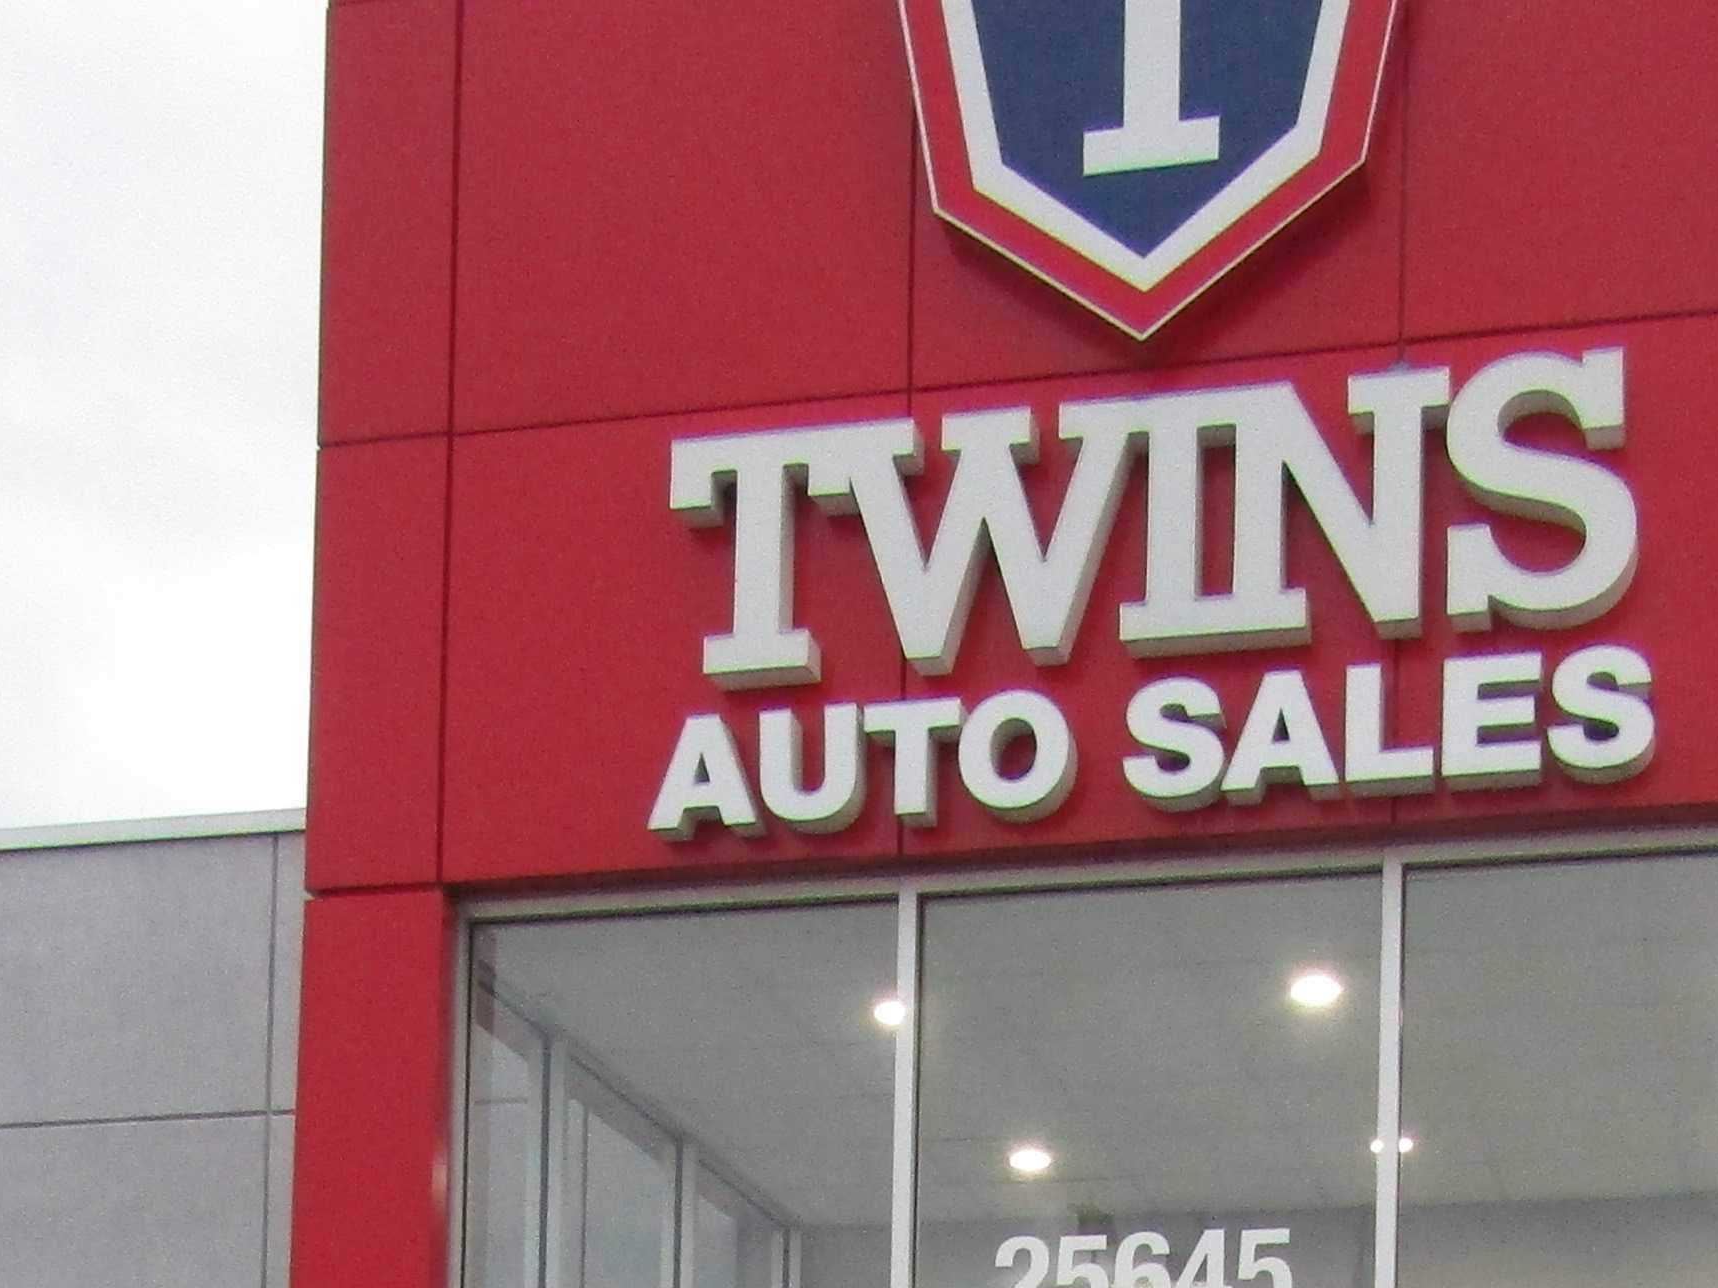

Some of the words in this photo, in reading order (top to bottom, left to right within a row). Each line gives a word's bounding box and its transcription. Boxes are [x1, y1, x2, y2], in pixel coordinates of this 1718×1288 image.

[670, 346, 1637, 690] TWINS
[647, 690, 1078, 841] AUTO
[1122, 644, 1656, 811] SALES
